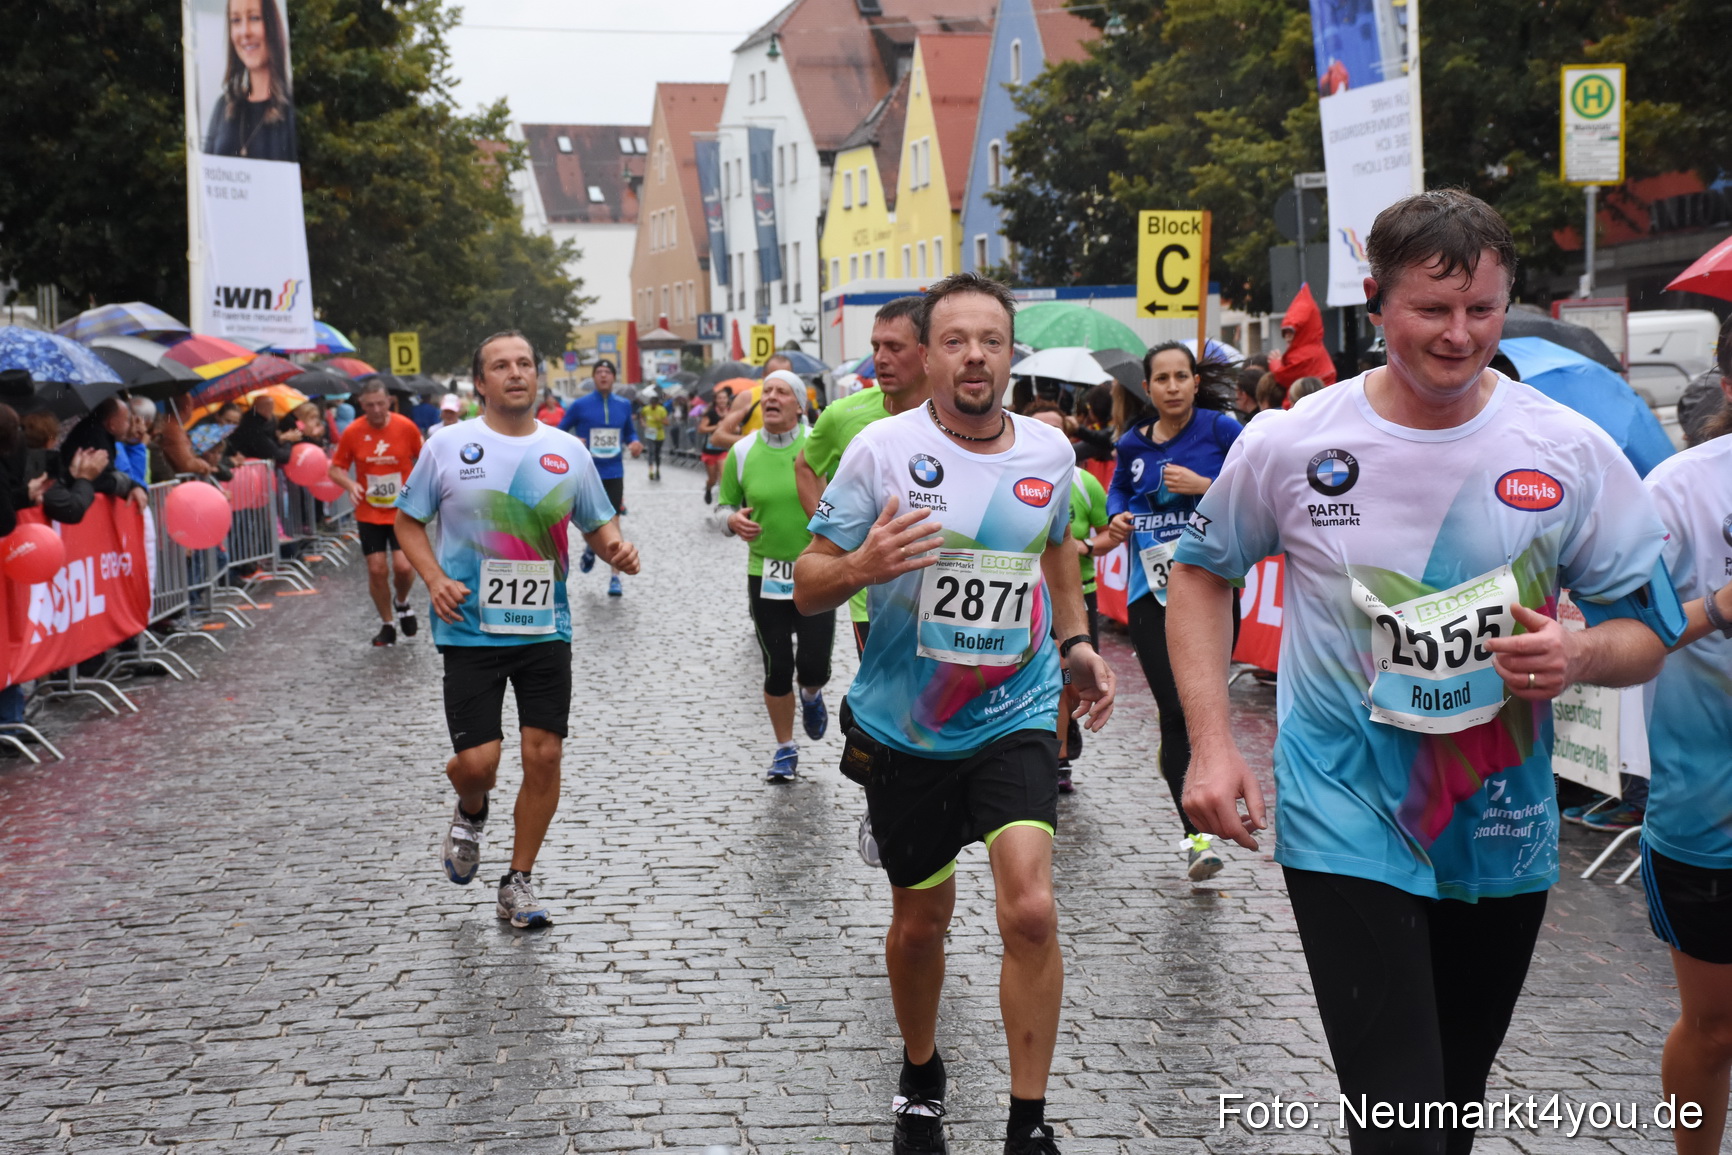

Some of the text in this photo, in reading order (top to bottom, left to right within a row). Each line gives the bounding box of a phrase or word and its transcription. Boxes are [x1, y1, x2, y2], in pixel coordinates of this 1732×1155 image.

[1148, 216, 1202, 235] Block
[1156, 244, 1190, 295] C
[398, 345, 412, 365] D
[756, 337, 769, 356] D
[544, 457, 567, 469] Hervis
[1311, 450, 1356, 466] BMW
[460, 467, 485, 476] PARTL
[1131, 458, 1145, 483] 9
[909, 490, 947, 505] PARTL
[1019, 484, 1051, 501] Hervis
[1506, 479, 1556, 500] Hervis
[909, 501, 947, 512] Neumarkt
[1308, 503, 1360, 517] PARTL
[1134, 510, 1193, 530] FIBAL
[1311, 517, 1360, 527] Neumarkt
[936, 561, 974, 569] NeuerMarkt
[981, 555, 1033, 571] BOCK
[488, 578, 550, 606] 2127
[934, 576, 1029, 622] 2871
[1415, 577, 1501, 622] BOCK
[504, 612, 534, 626] Siega
[954, 631, 1005, 651] Robert
[1376, 605, 1503, 671] 2555
[1411, 681, 1471, 711] Roland
